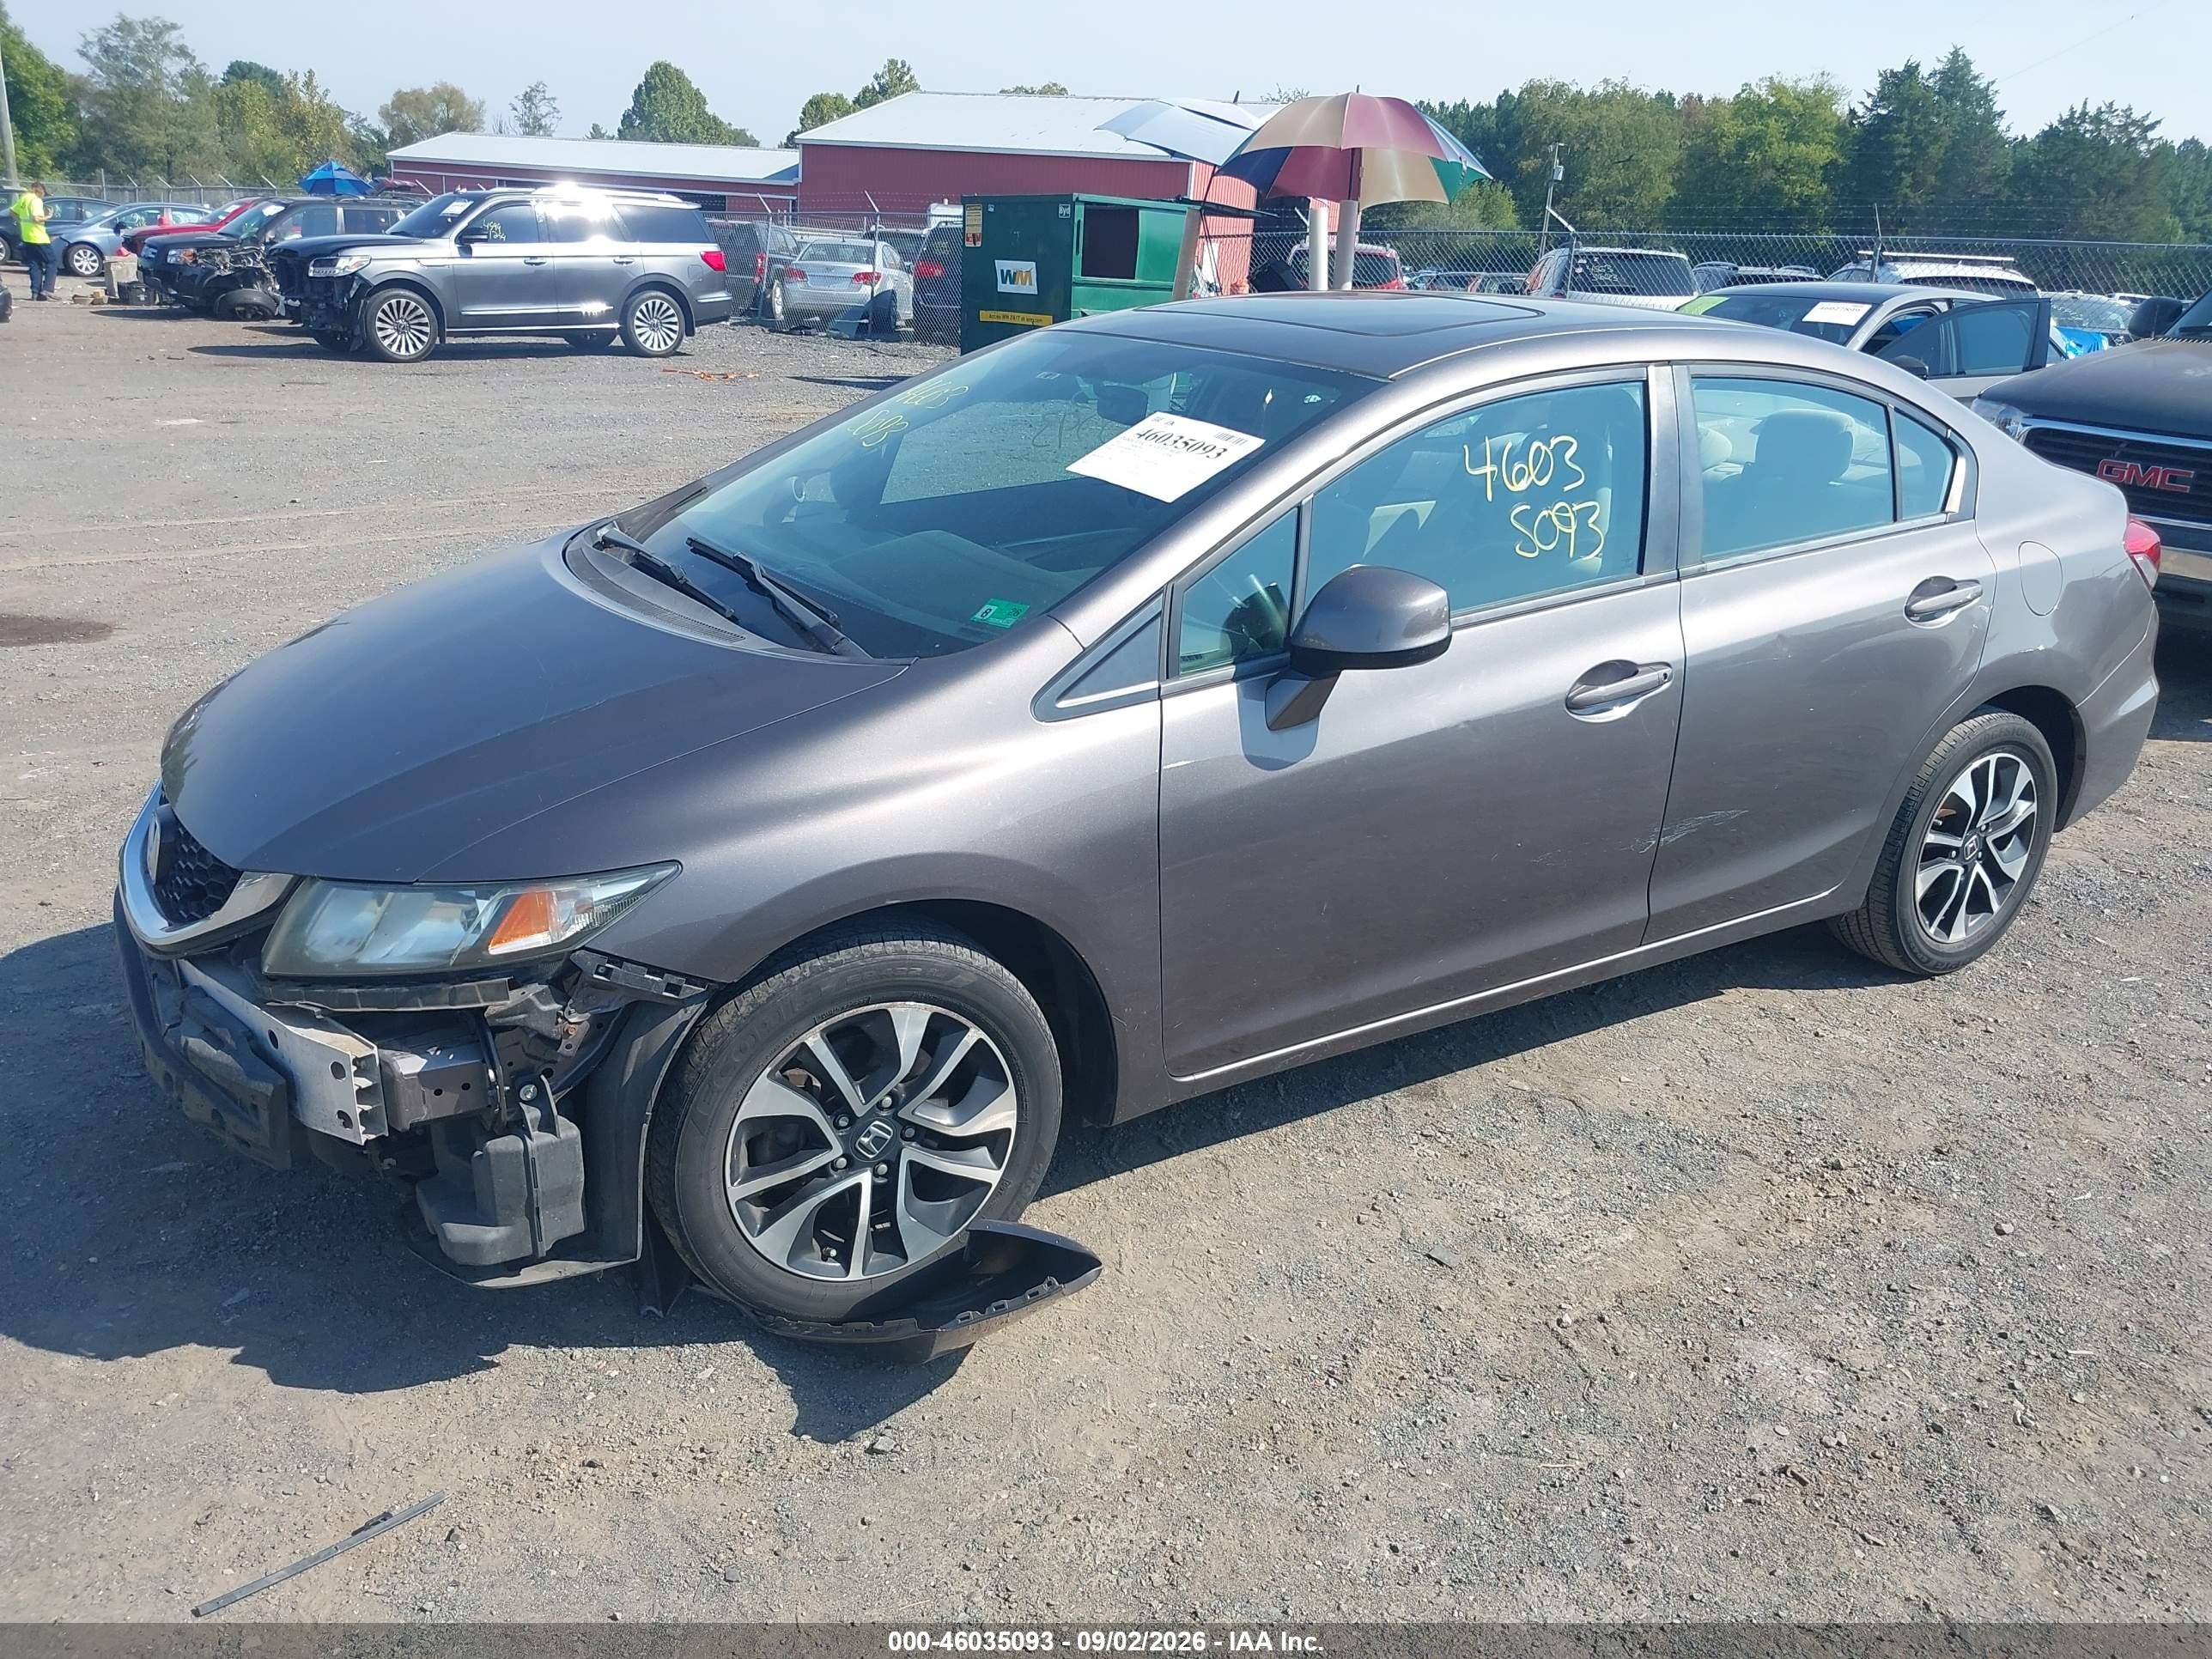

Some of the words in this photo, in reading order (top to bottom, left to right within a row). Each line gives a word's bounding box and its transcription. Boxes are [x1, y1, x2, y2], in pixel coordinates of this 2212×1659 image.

[1000, 268, 1033, 286] WM
[1135, 428, 1228, 459] 46035093
[1462, 434, 1585, 501] 4603
[2096, 459, 2195, 493] GMC
[1510, 501, 1605, 559] 5093
[981, 608, 993, 618] 8
